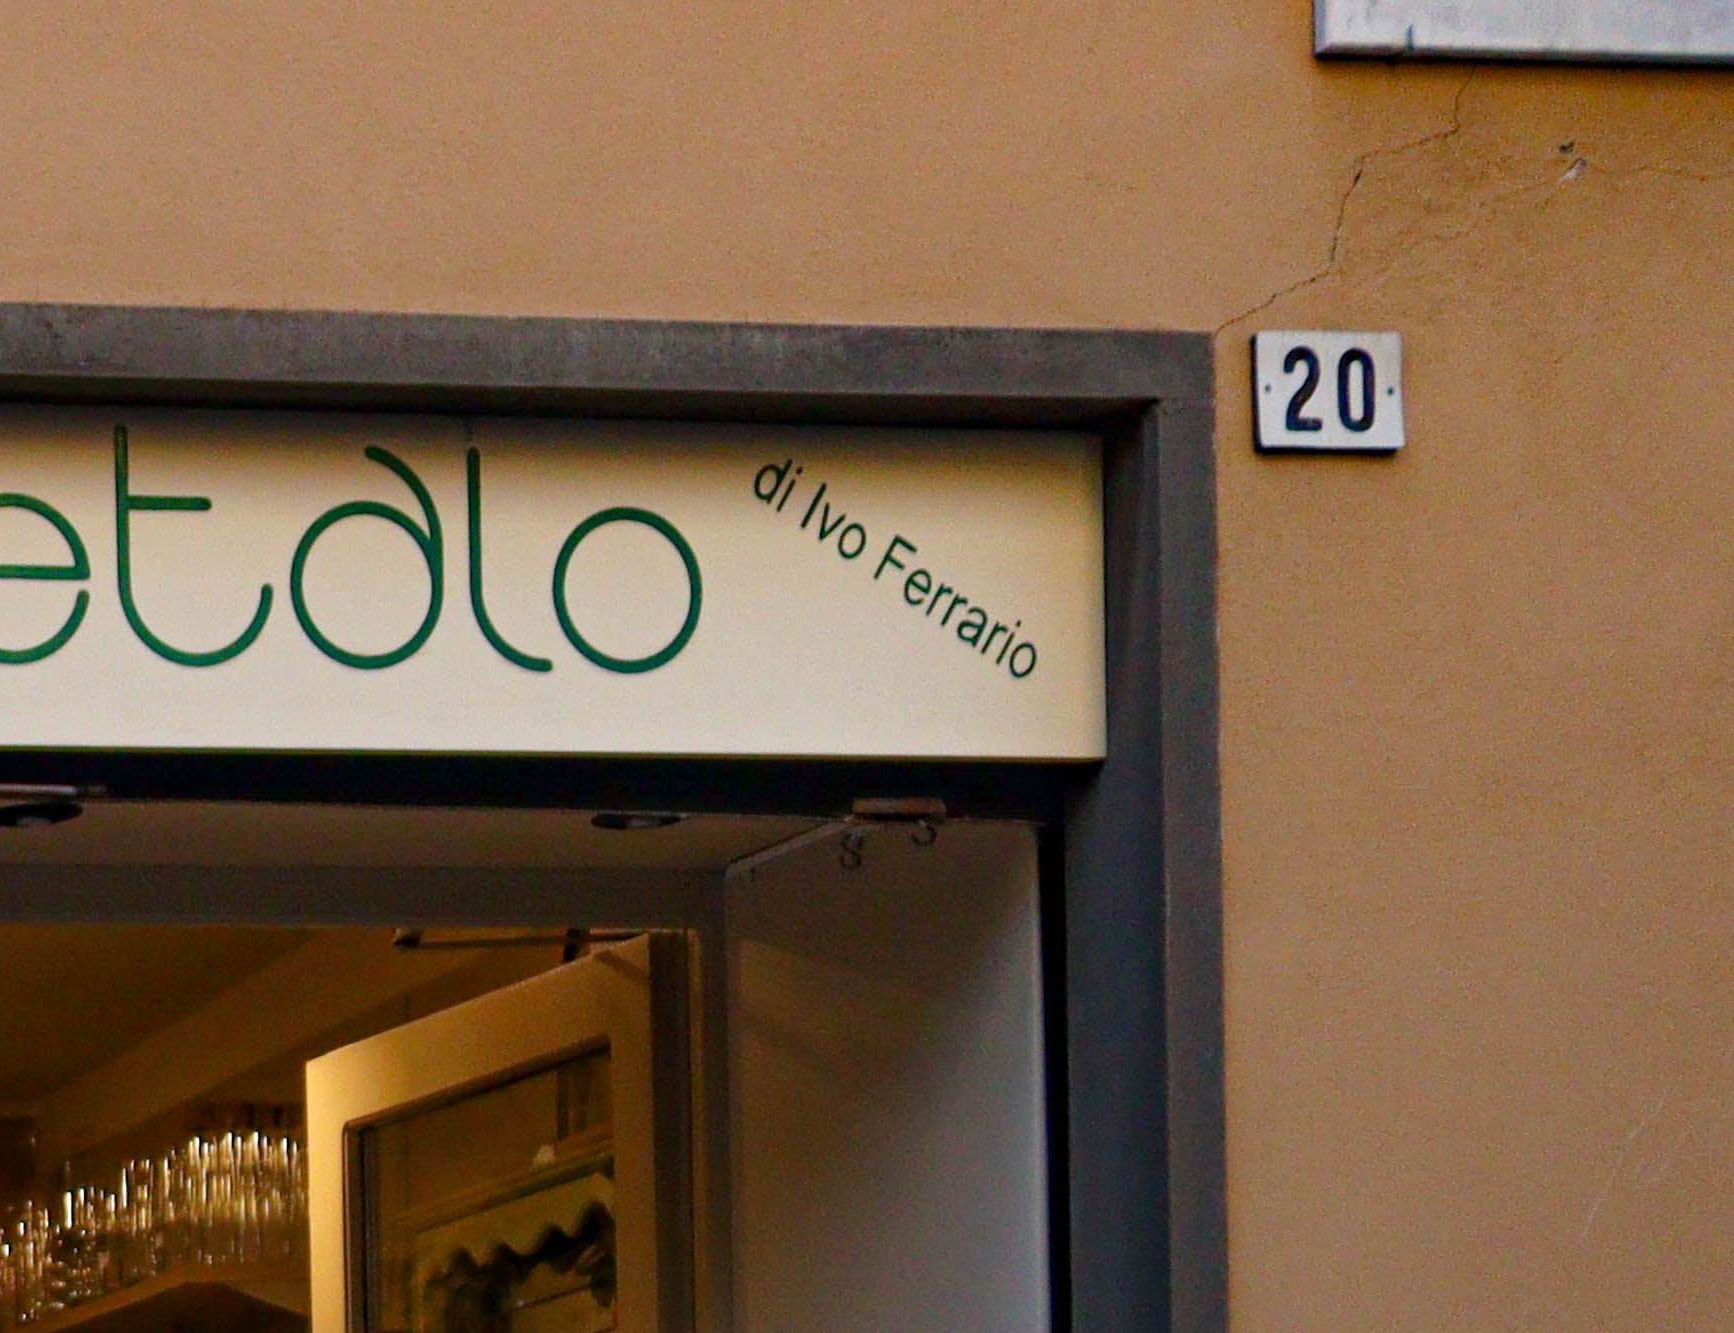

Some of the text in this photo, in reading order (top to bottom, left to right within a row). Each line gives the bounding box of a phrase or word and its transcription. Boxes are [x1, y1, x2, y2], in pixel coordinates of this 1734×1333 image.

[1283, 345, 1376, 432] 20
[753, 458, 1038, 679] di Ivo Ferrario
